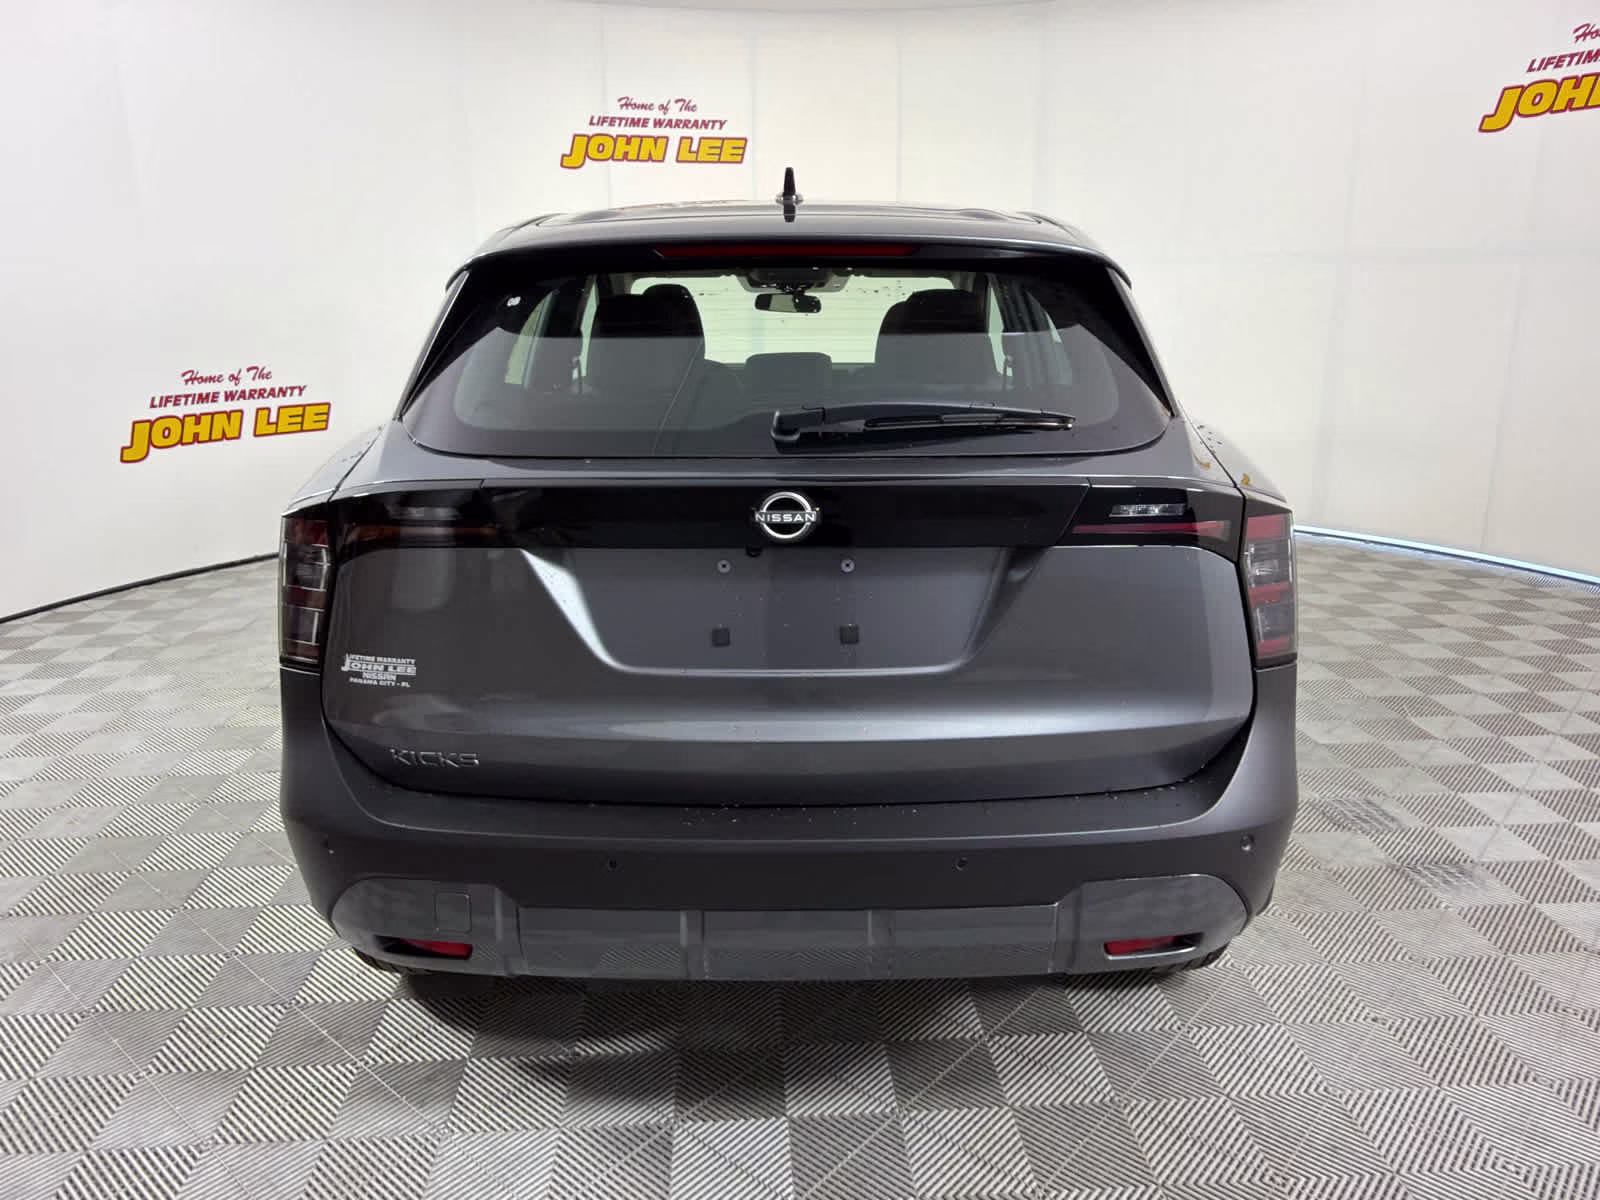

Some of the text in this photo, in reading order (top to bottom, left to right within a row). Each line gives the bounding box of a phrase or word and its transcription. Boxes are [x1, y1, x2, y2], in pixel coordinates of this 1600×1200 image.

[1526, 48, 1600, 72] LIFETIM
[617, 96, 698, 115] Home of The
[589, 116, 727, 130] LIFETIME WARRANTY
[560, 133, 748, 169] JOHN LEE
[181, 366, 272, 386] Home of The
[149, 385, 307, 409] LIFETIME WARRANTY
[120, 402, 332, 464] JOHN LEE
[755, 512, 816, 522] NISSAN
[389, 749, 479, 768] KICKS
